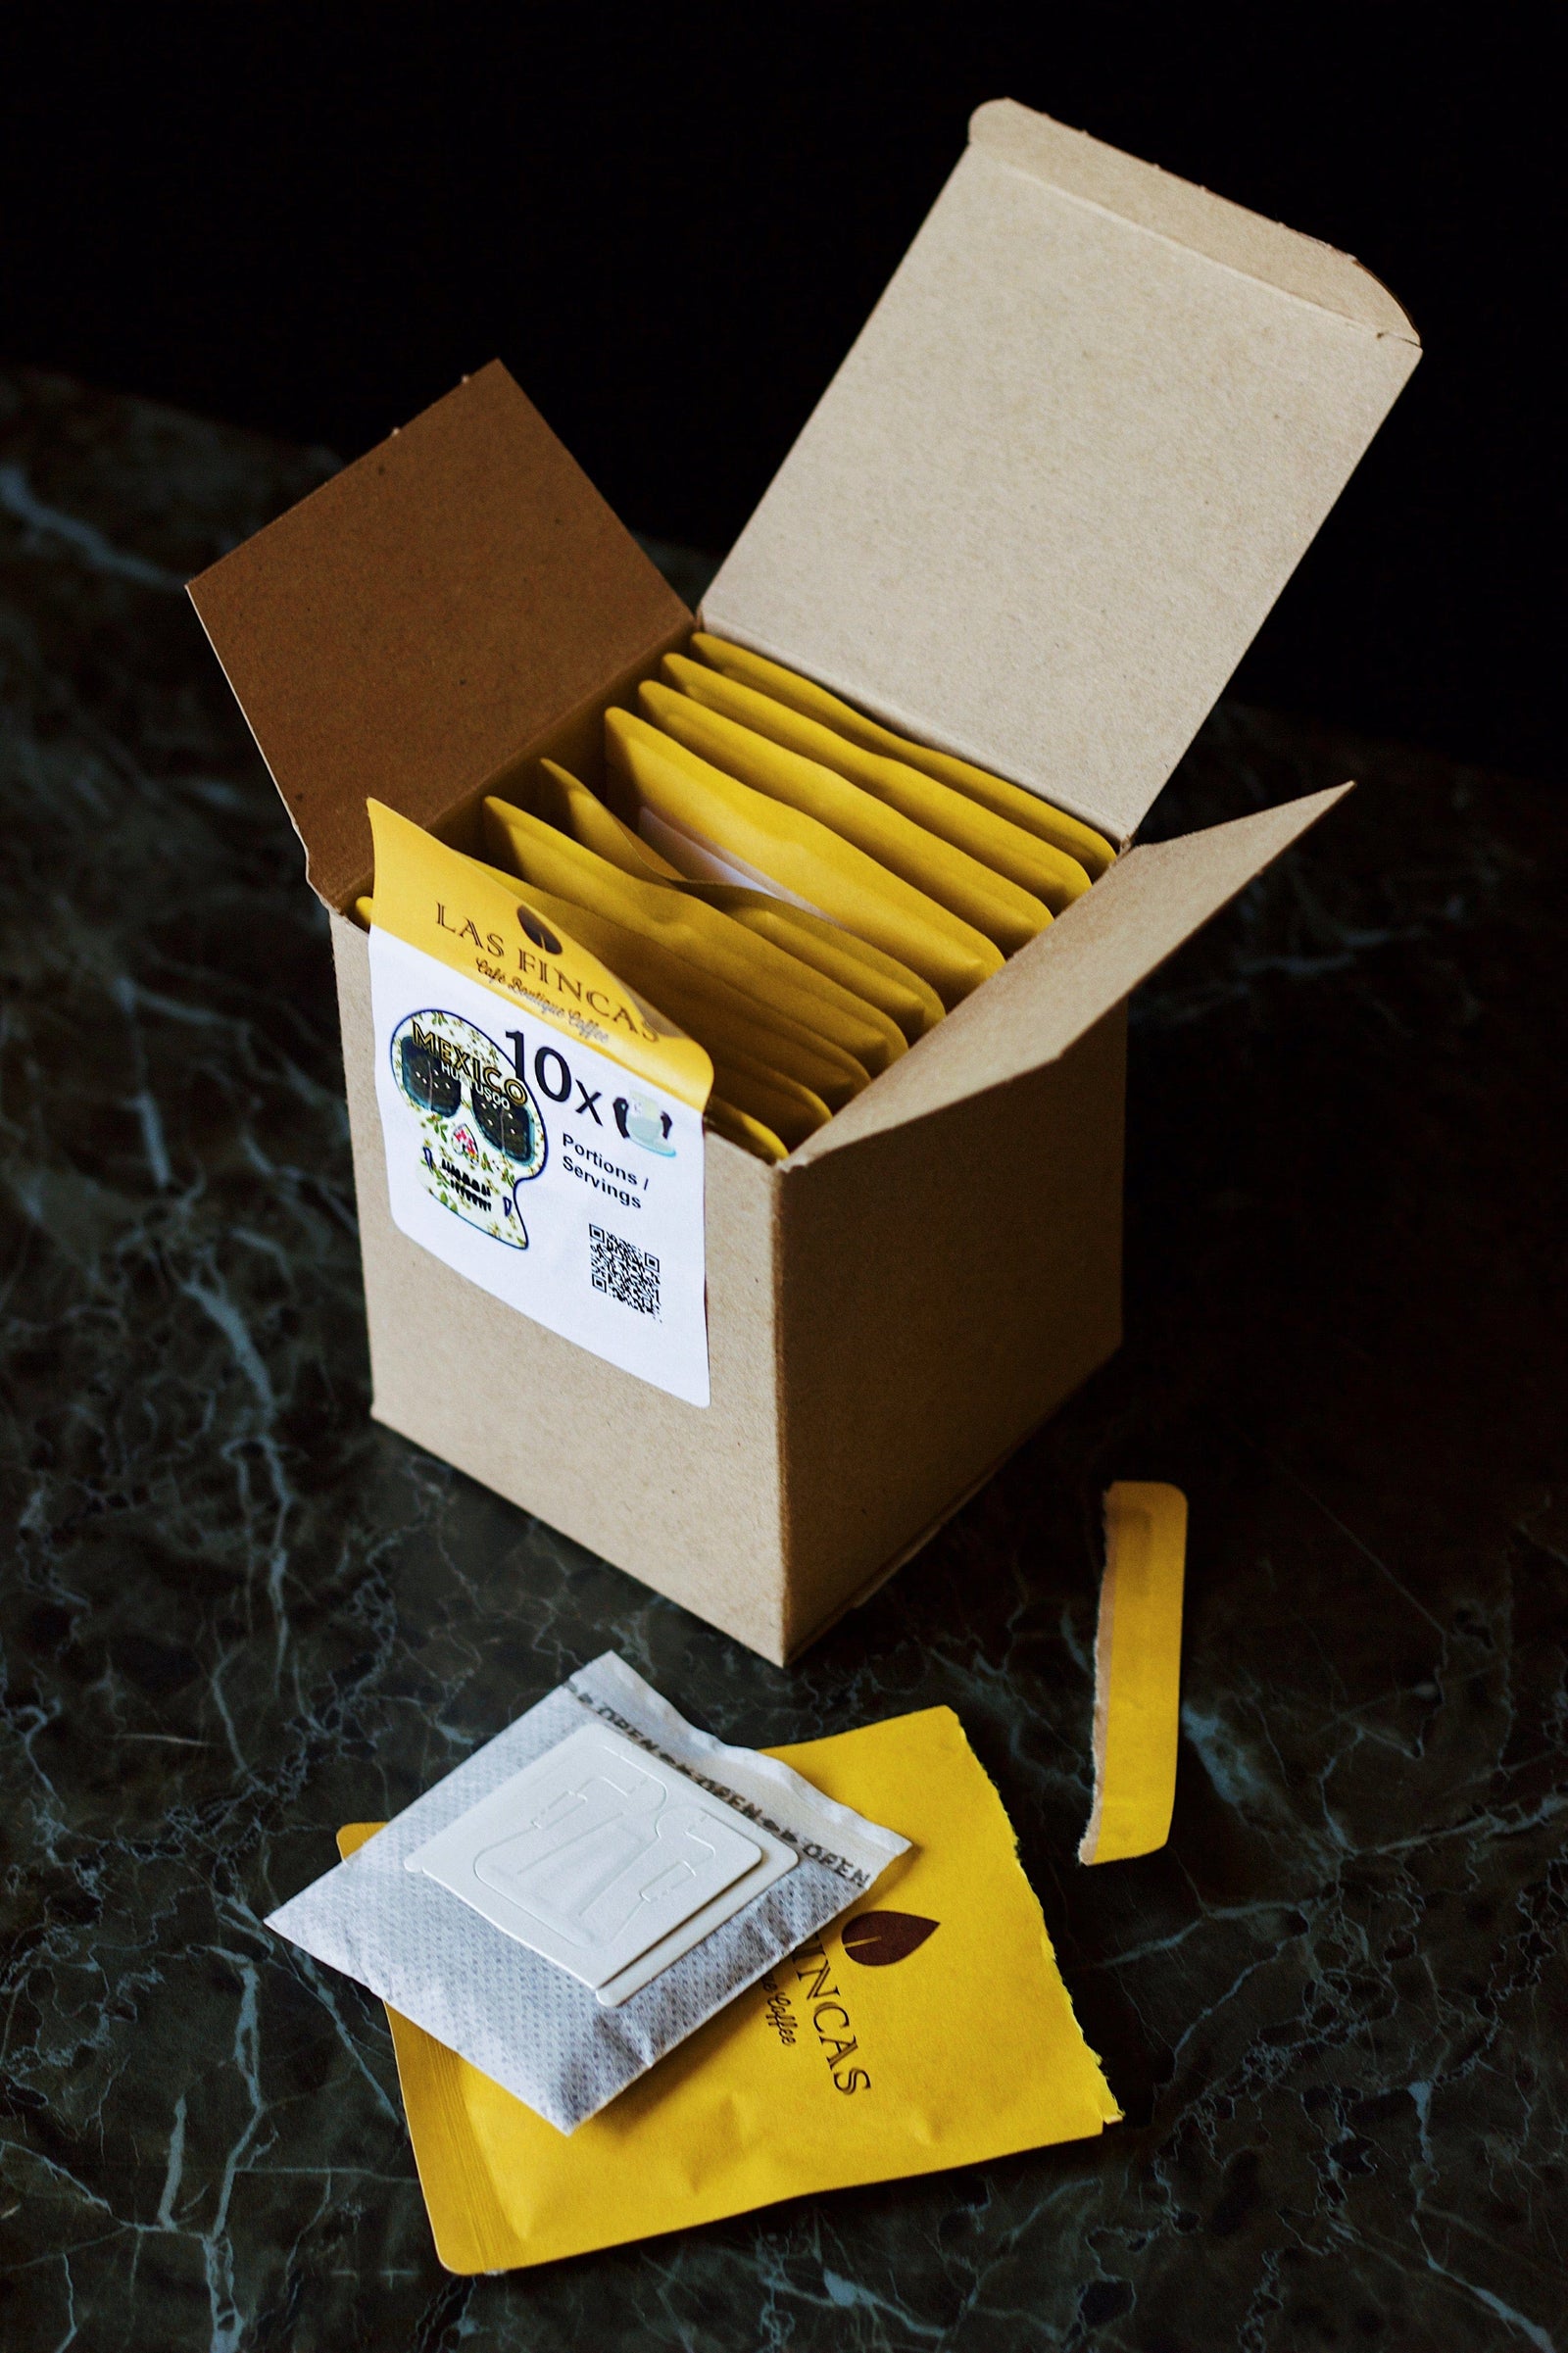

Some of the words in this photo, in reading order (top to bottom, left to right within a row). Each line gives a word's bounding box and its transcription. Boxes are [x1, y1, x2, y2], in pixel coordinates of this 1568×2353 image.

[436, 902, 505, 957] LAS
[518, 947, 662, 1044] FINCAS
[567, 1008, 610, 1044] Coffee
[412, 1019, 527, 1106] MEXICO
[563, 1133, 637, 1186] Portions
[643, 1177, 649, 1191] /
[563, 1155, 642, 1209] Servings
[803, 1841, 870, 1889] OPEN
[765, 1991, 797, 2047] Coffee
[792, 1933, 871, 2095] INCAS
